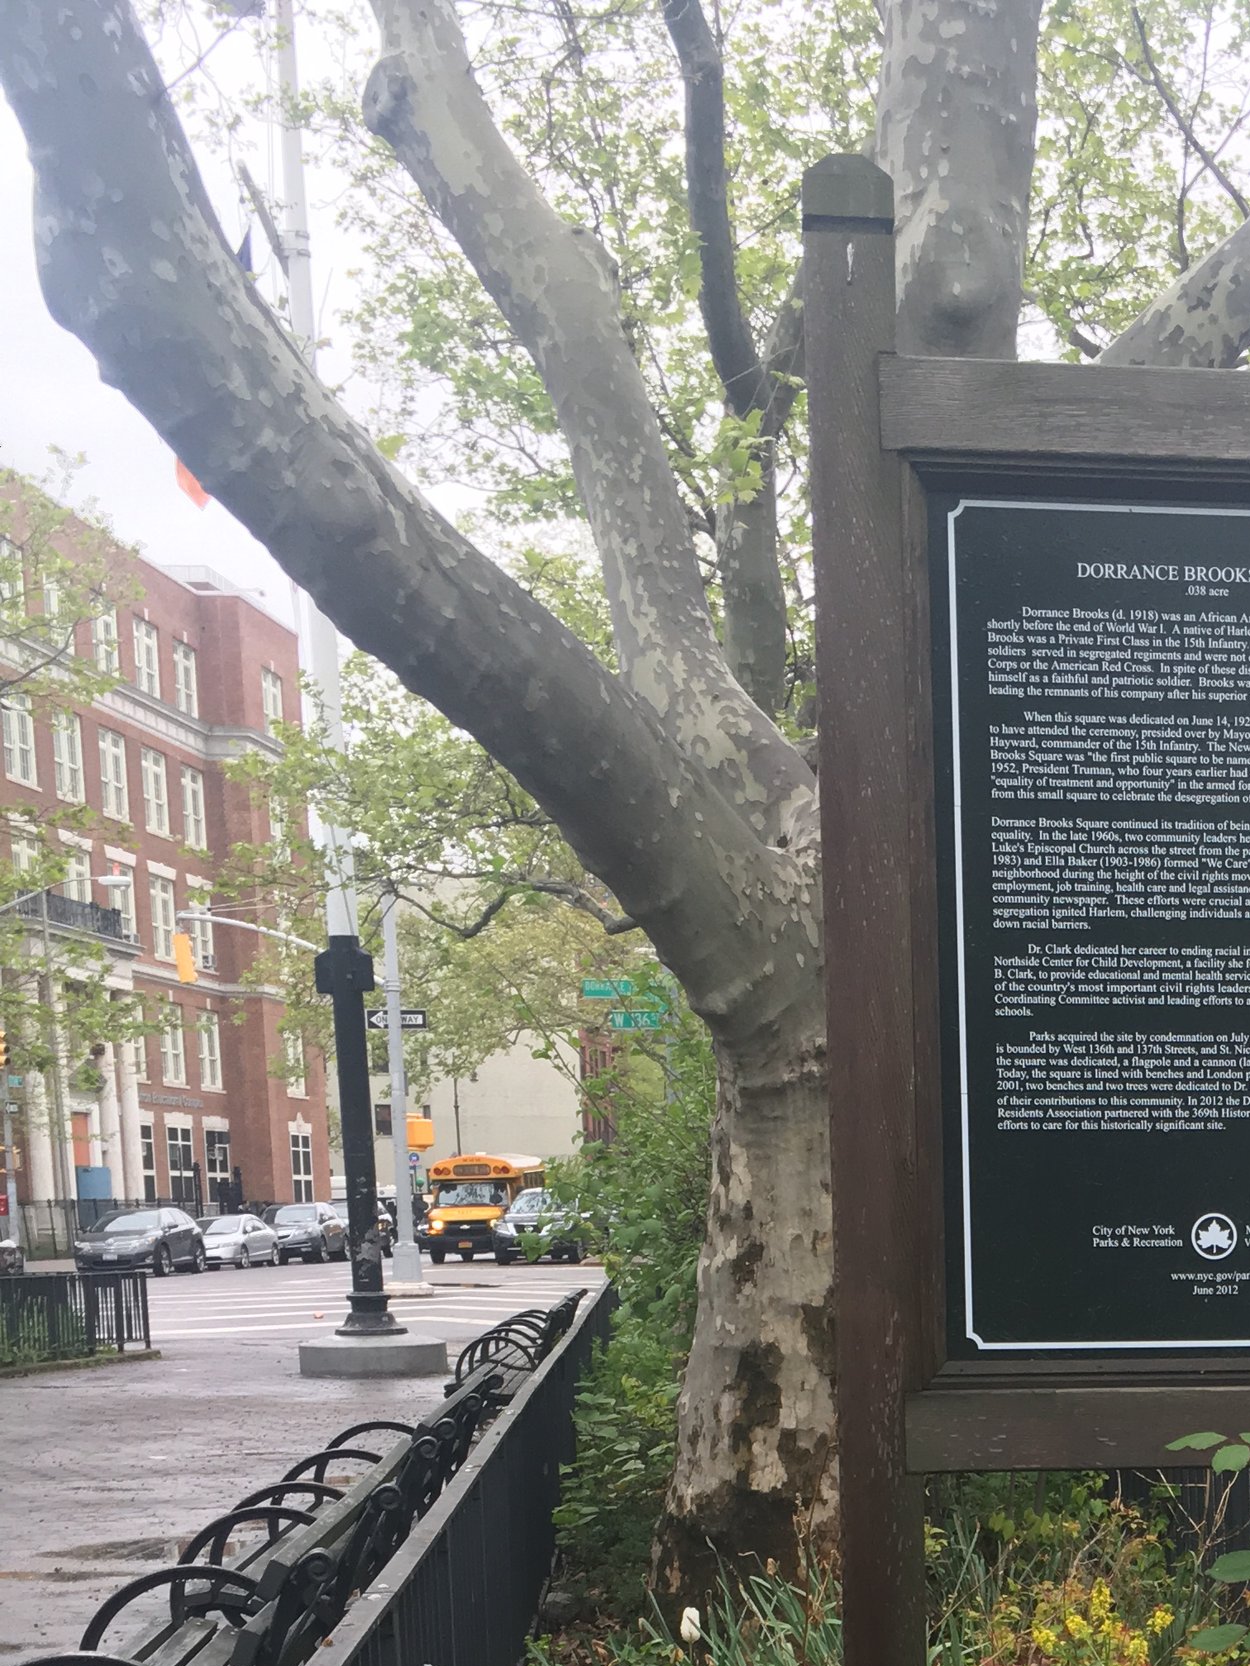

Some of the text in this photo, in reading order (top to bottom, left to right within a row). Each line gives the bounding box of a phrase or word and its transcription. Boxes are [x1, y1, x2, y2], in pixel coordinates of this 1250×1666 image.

[1077, 562, 1179, 581] DORRANCE
[1185, 584, 1229, 596] .038 acre
[1022, 606, 1069, 618] Dorrance
[1072, 607, 1109, 619] Brooks
[1111, 608, 1125, 620] (d.
[1130, 609, 1158, 621] 1918)
[1161, 613, 1181, 621] was
[1183, 613, 1196, 621] an
[1198, 611, 1237, 623] African
[987, 657, 1017, 670] Corps
[1019, 661, 1031, 669] or
[1033, 658, 1048, 670] the
[1051, 658, 1099, 671] American
[1101, 659, 1121, 671] Red
[1123, 660, 1154, 672] Cross.
[1160, 662, 1170, 673] In
[1172, 662, 1196, 674] spite
[1198, 663, 1210, 674] of
[1211, 663, 1236, 674] these
[1023, 711, 1052, 722] When
[1054, 711, 1072, 722] this
[1074, 715, 1106, 724] square
[1108, 715, 1127, 724] was
[1129, 713, 1174, 725] dedicated
[1176, 717, 1189, 725] on
[1191, 715, 1213, 726] June
[1217, 715, 1232, 727] 14,
[991, 761, 1019, 774] 1952,
[1021, 761, 1069, 774] President
[1071, 764, 1114, 776] Truman,
[1117, 763, 1139, 775] who
[1142, 765, 1163, 776] four
[1165, 768, 1192, 777] years
[1195, 766, 1227, 777] earlier
[1229, 767, 1248, 777] had
[991, 816, 1036, 827] Dorrance
[1038, 817, 1073, 828] Brooks
[1075, 817, 1109, 829] Square
[1111, 818, 1158, 829] continued
[1161, 819, 1172, 829] its
[1174, 819, 1214, 830] tradition
[1216, 819, 1228, 830] of
[992, 904, 1049, 917] segregation
[1051, 905, 1086, 917] ignited
[1088, 905, 1128, 918] Harlem,
[1130, 906, 1186, 918] challenging
[1189, 907, 1242, 918] individuals
[992, 916, 1091, 929] down racial barriers.
[994, 980, 1007, 991] of
[1008, 980, 1025, 991] the
[1027, 980, 1075, 992] country's
[1078, 983, 1103, 992] most
[1106, 981, 1156, 993] important
[1159, 982, 1182, 992] civil
[1185, 982, 1214, 993] rights
[994, 1005, 1033, 1016] schools.
[401, 1016, 419, 1024] WAY
[613, 1013, 625, 1027] W
[1029, 1031, 1055, 1041] Parks
[1057, 1031, 1097, 1042] acquired
[1099, 1031, 1114, 1041] the
[1115, 1031, 1133, 1041] site
[1135, 1031, 1147, 1042] by
[1149, 1031, 1214, 1042] condemnation
[1216, 1034, 1228, 1042] on
[1229, 1032, 1249, 1043] July
[1092, 1225, 1175, 1237] City of New York
[1092, 1236, 1182, 1247] Parks & Recreation
[1192, 1284, 1238, 1294] June 2012
